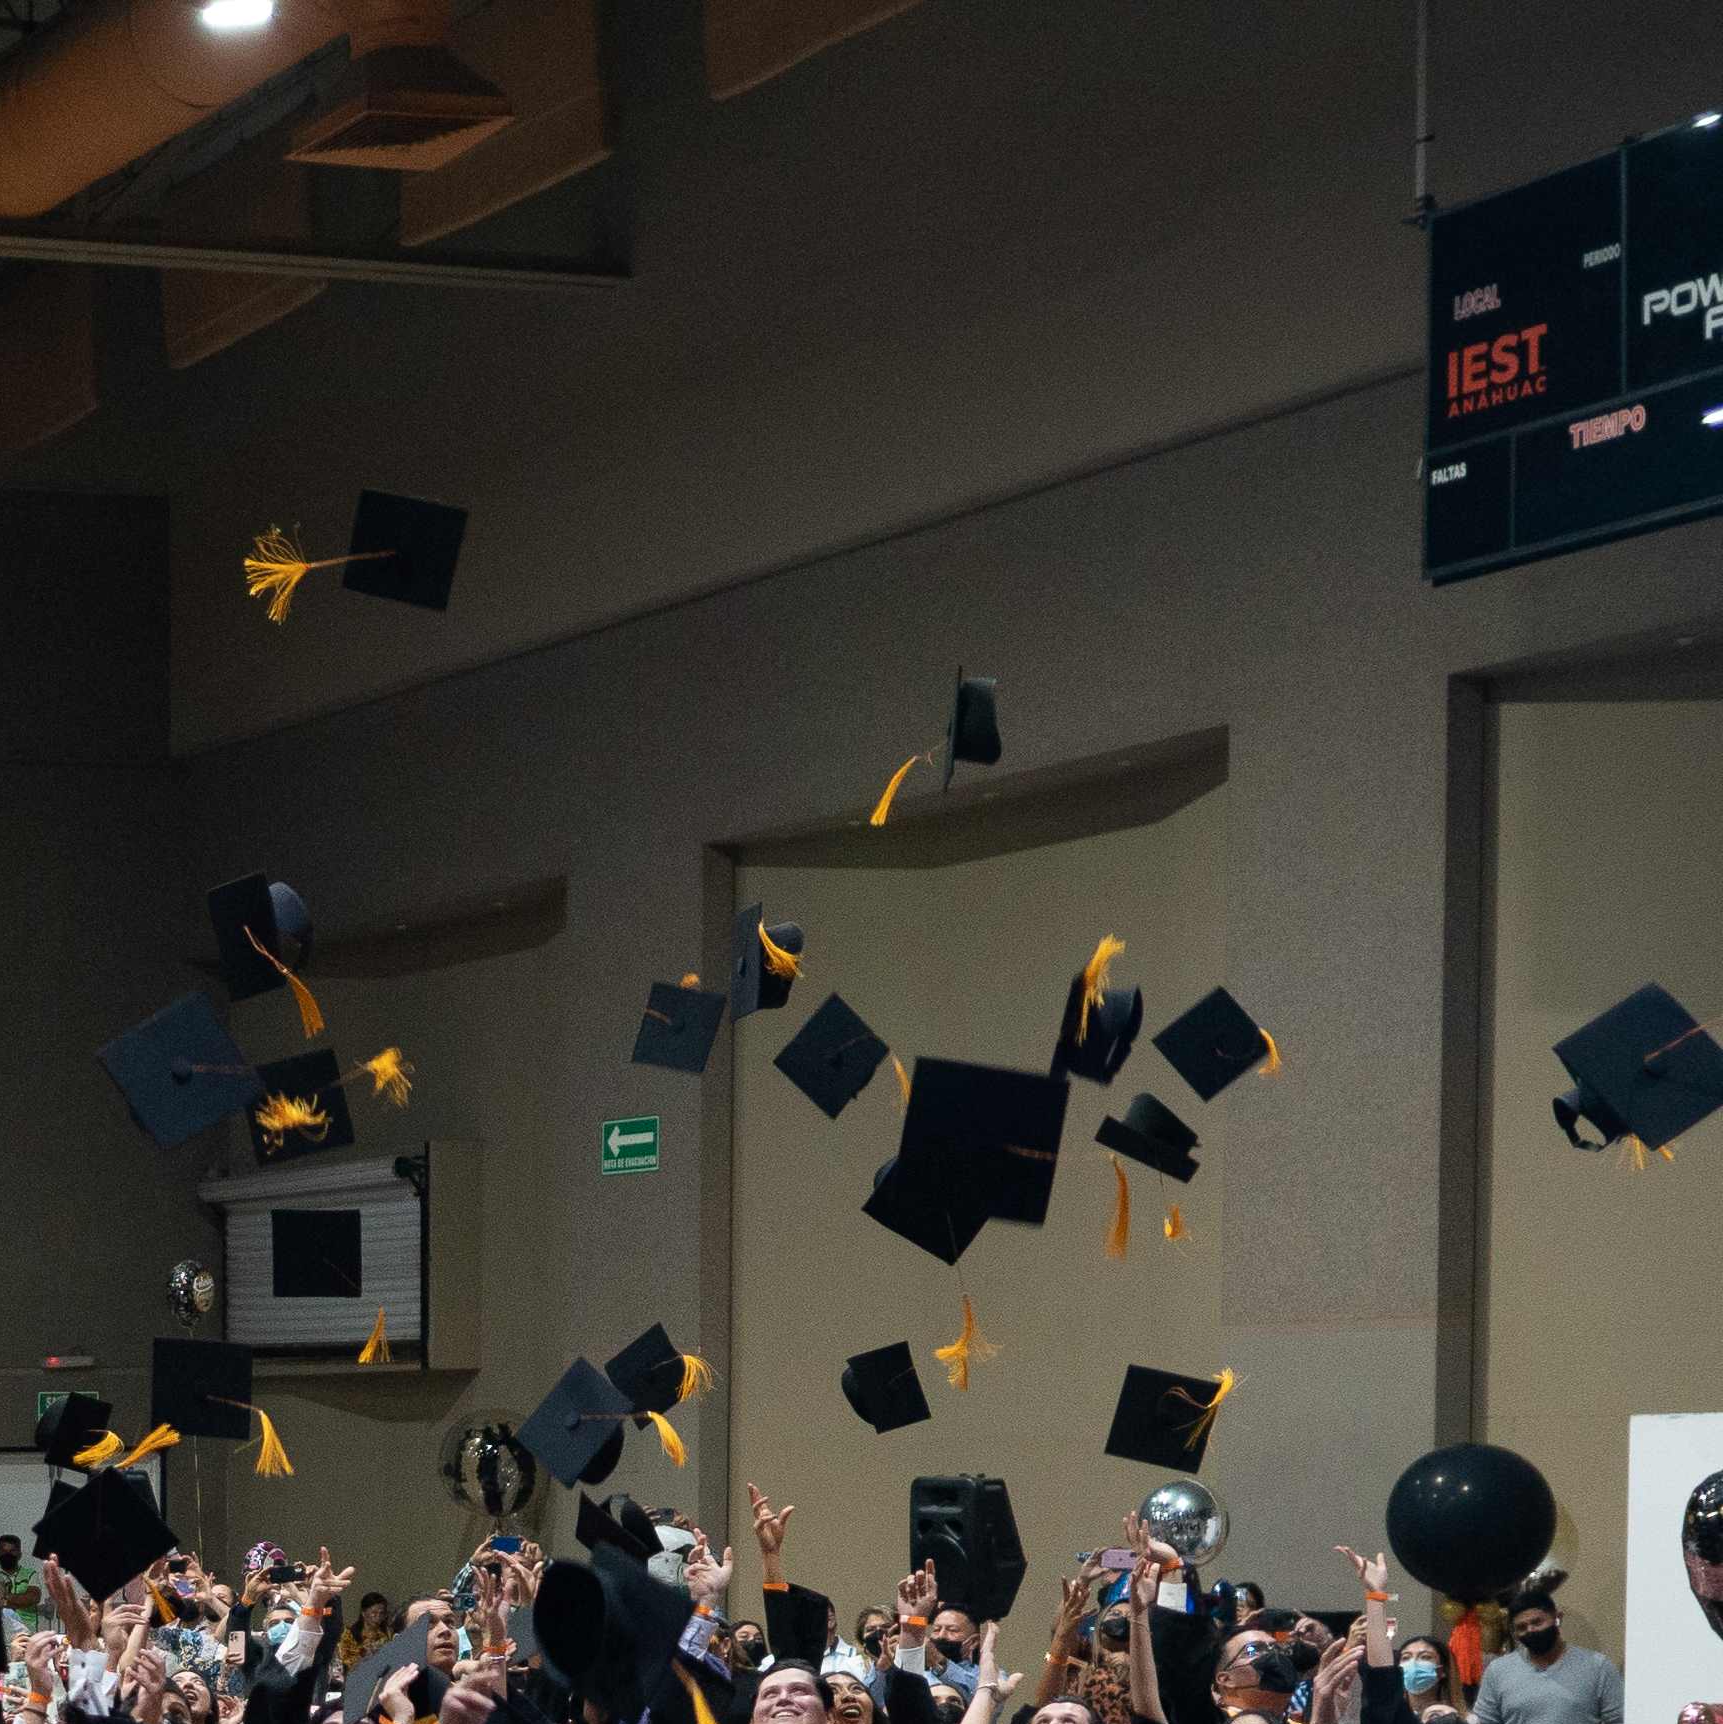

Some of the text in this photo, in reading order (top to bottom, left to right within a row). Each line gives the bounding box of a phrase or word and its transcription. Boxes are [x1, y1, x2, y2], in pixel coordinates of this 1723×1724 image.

[1453, 284, 1501, 321] LOCAL
[1447, 323, 1548, 399] IEST
[1447, 376, 1548, 418] ANAHUAC
[1569, 404, 1647, 450] TIEMPO
[1431, 462, 1467, 486] FALTAS
